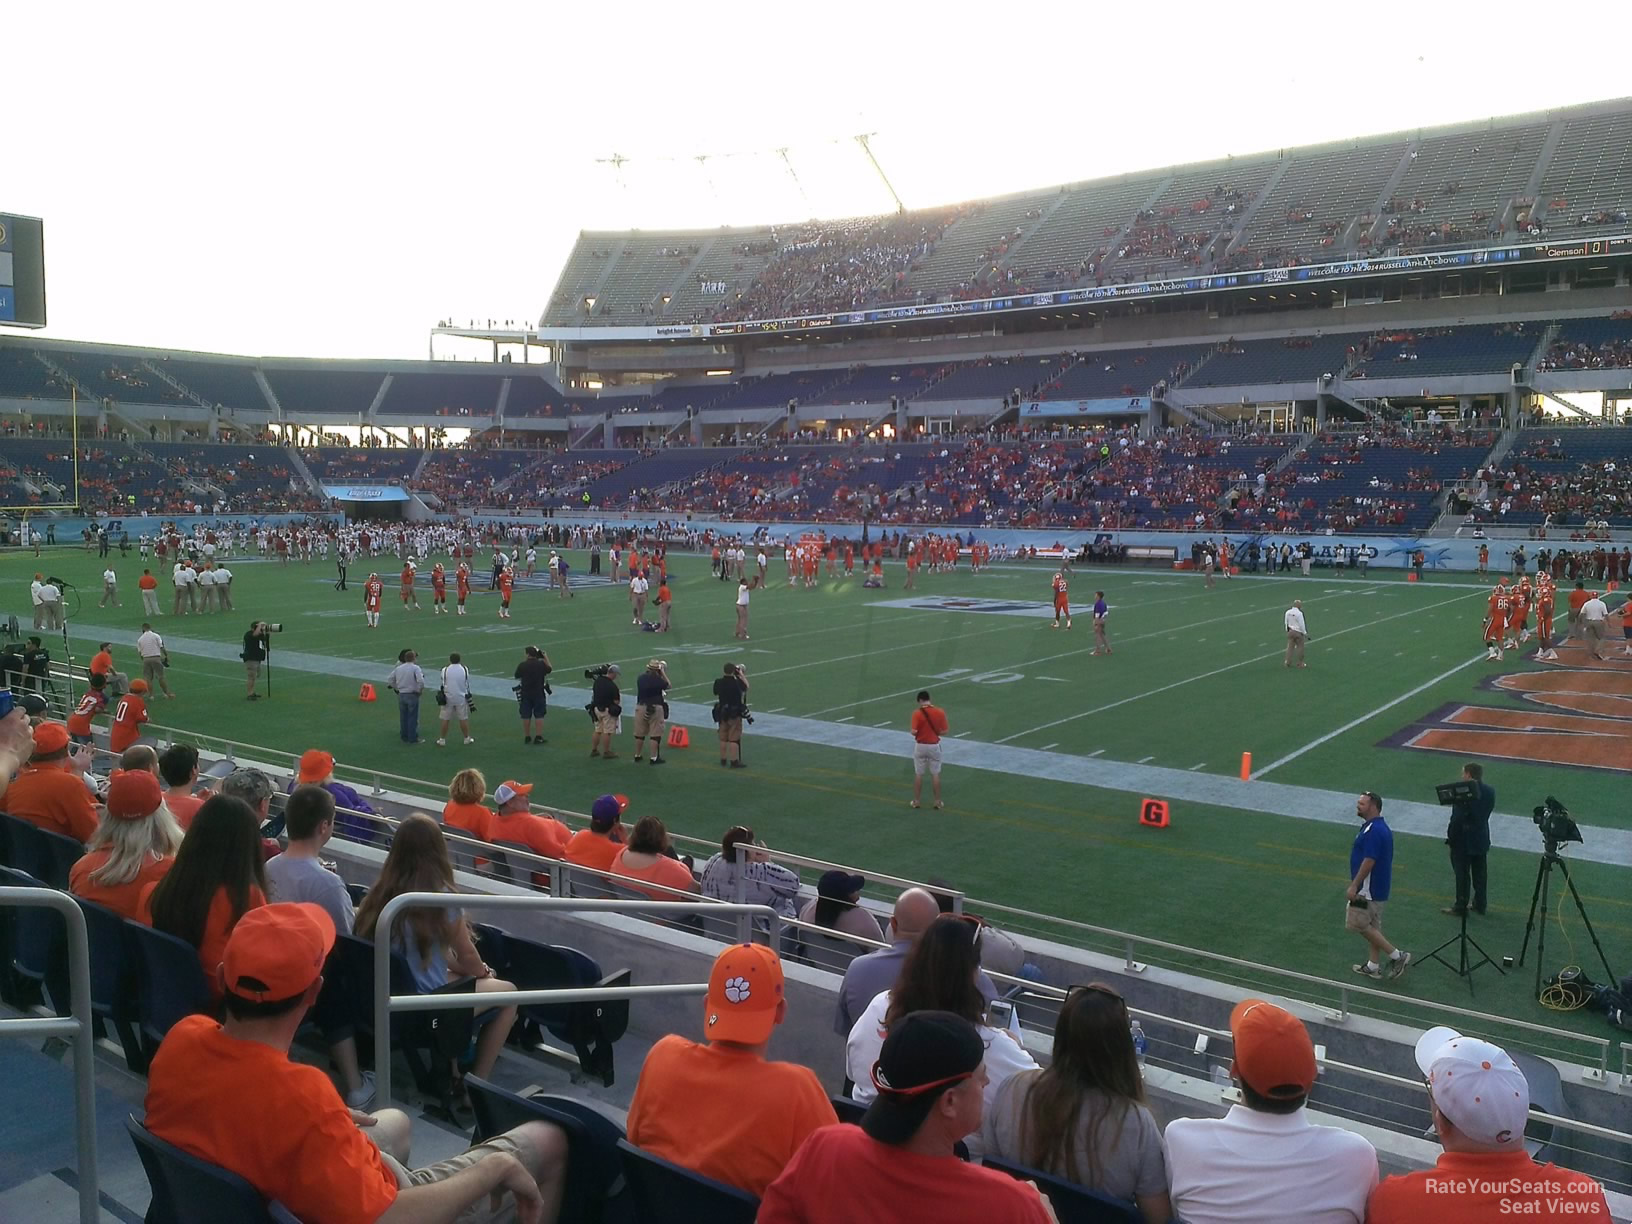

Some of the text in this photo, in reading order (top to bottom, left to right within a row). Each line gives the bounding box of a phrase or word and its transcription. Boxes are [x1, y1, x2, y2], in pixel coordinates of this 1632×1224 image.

[1547, 242, 1600, 257] Clemson 0
[1308, 267, 1339, 277] WELCOME
[1362, 264, 1378, 272] 2014
[1379, 263, 1405, 271] RUSSELL
[1406, 260, 1437, 268] ATHLETIC
[1438, 257, 1460, 265] BOWL
[370, 583, 380, 592] 38
[1059, 580, 1067, 592] 22
[1497, 598, 1509, 610] 86
[671, 728, 683, 744] 10
[1144, 801, 1164, 824] G
[432, 1018, 438, 1029] E
[1495, 1130, 1512, 1144] C
